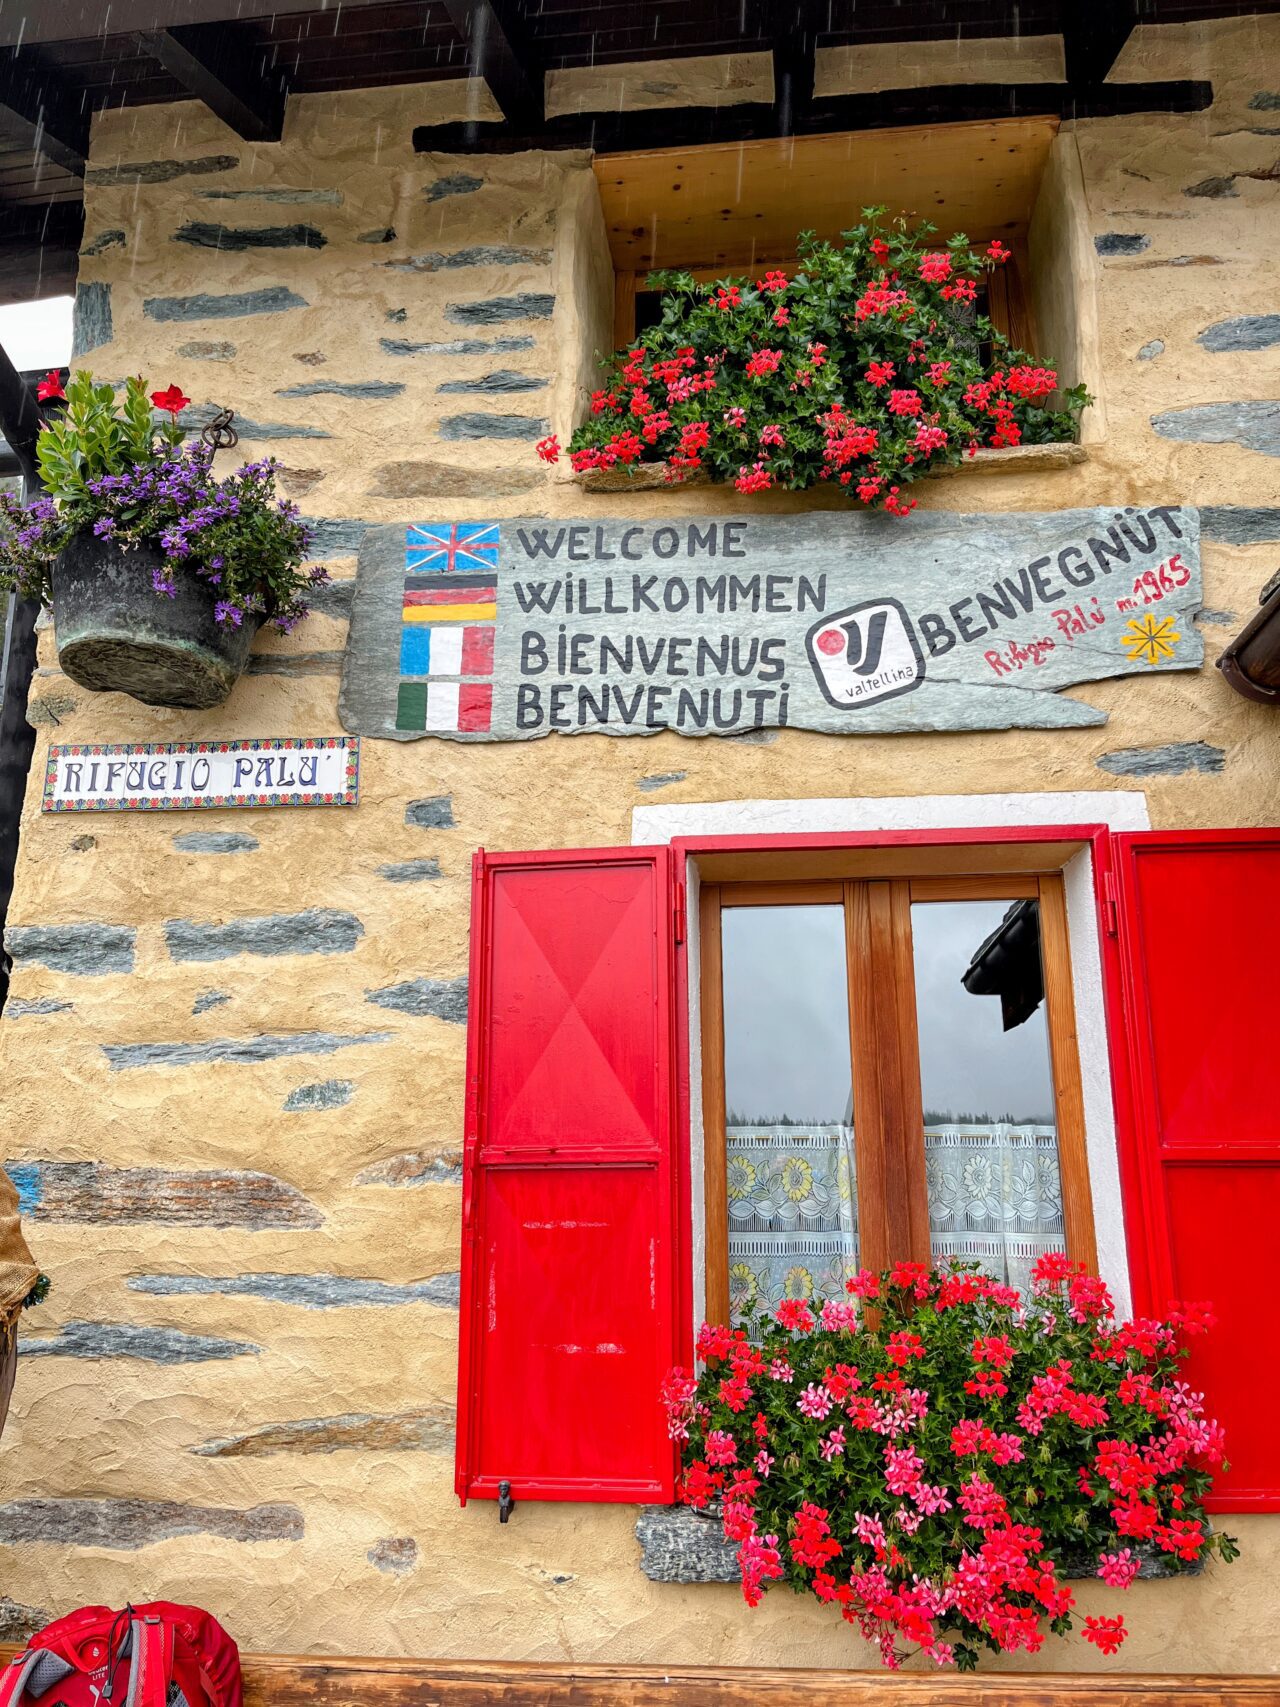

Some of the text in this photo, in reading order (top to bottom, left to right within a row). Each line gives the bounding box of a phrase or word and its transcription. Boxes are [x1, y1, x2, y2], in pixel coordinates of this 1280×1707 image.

[516, 523, 748, 560] WELCOME
[1132, 553, 1192, 605] 1965
[845, 666, 914, 697] valtellina
[63, 759, 211, 793] RIFUGIO
[92, 1672, 105, 1681] LITE
